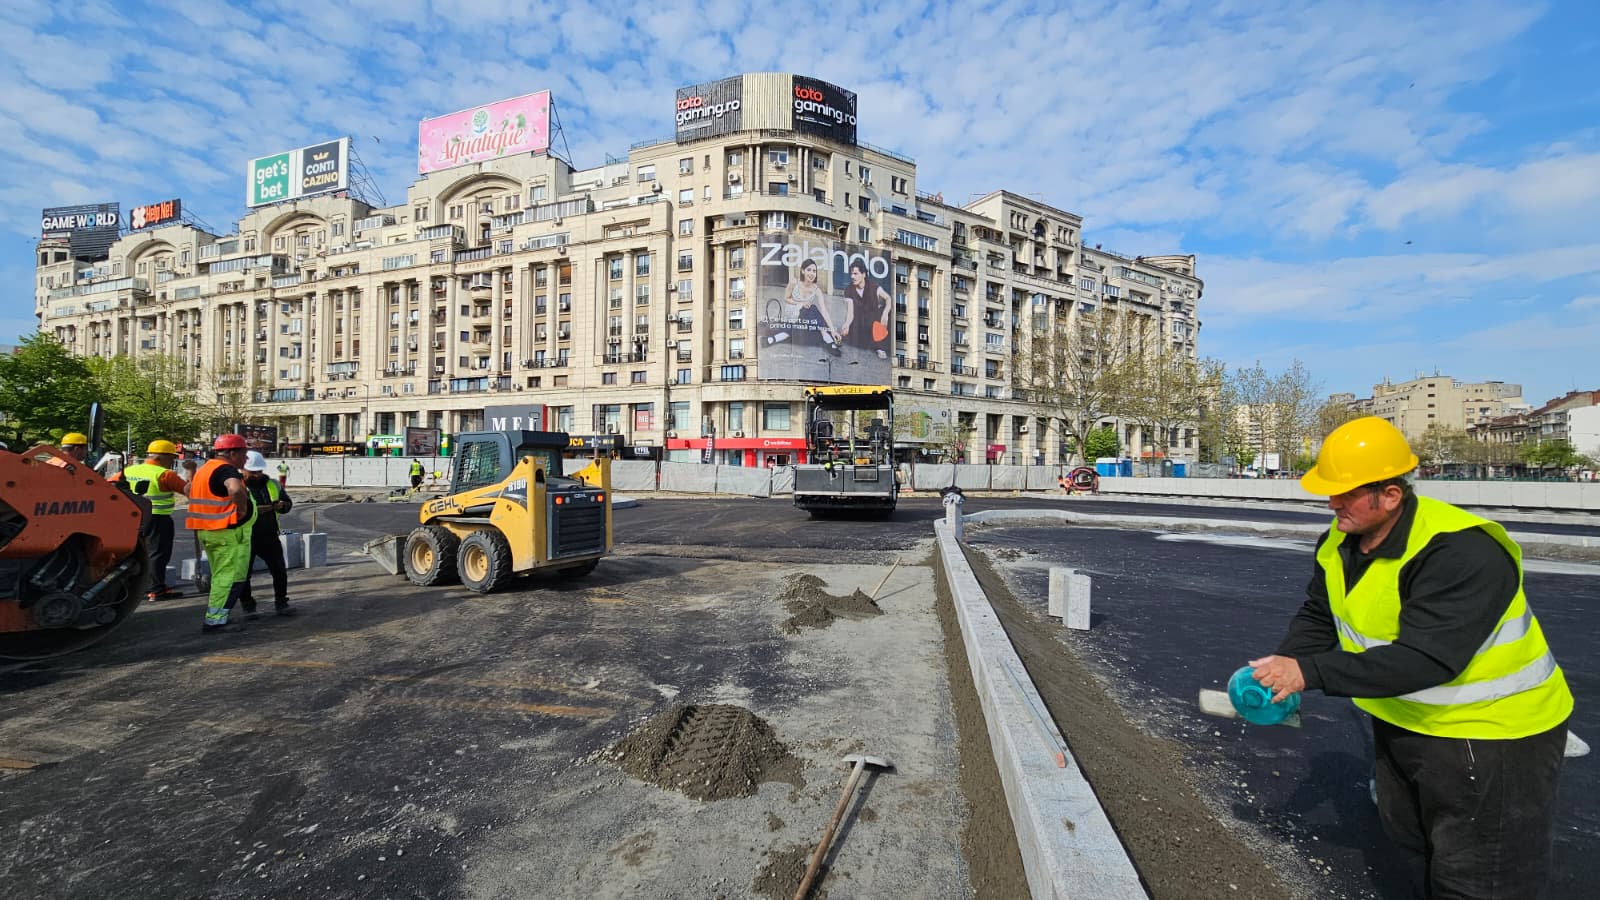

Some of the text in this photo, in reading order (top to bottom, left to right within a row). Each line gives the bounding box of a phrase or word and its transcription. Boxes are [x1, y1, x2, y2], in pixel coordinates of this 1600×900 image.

[794, 86, 823, 102] toto
[676, 97, 702, 110] toto
[676, 100, 740, 126] gaming.ro
[794, 100, 857, 125] gaming.ro
[440, 129, 523, 164] Aquatique
[256, 160, 288, 184] get's
[305, 160, 335, 175] CONTI
[303, 171, 338, 188] CAZINO
[260, 182, 282, 199] bet
[41, 212, 117, 230] GAME WORLD
[145, 201, 174, 224] Help Net
[760, 240, 889, 279] zalando
[33, 500, 96, 517] HAMM
[429, 498, 460, 514] GEHL
